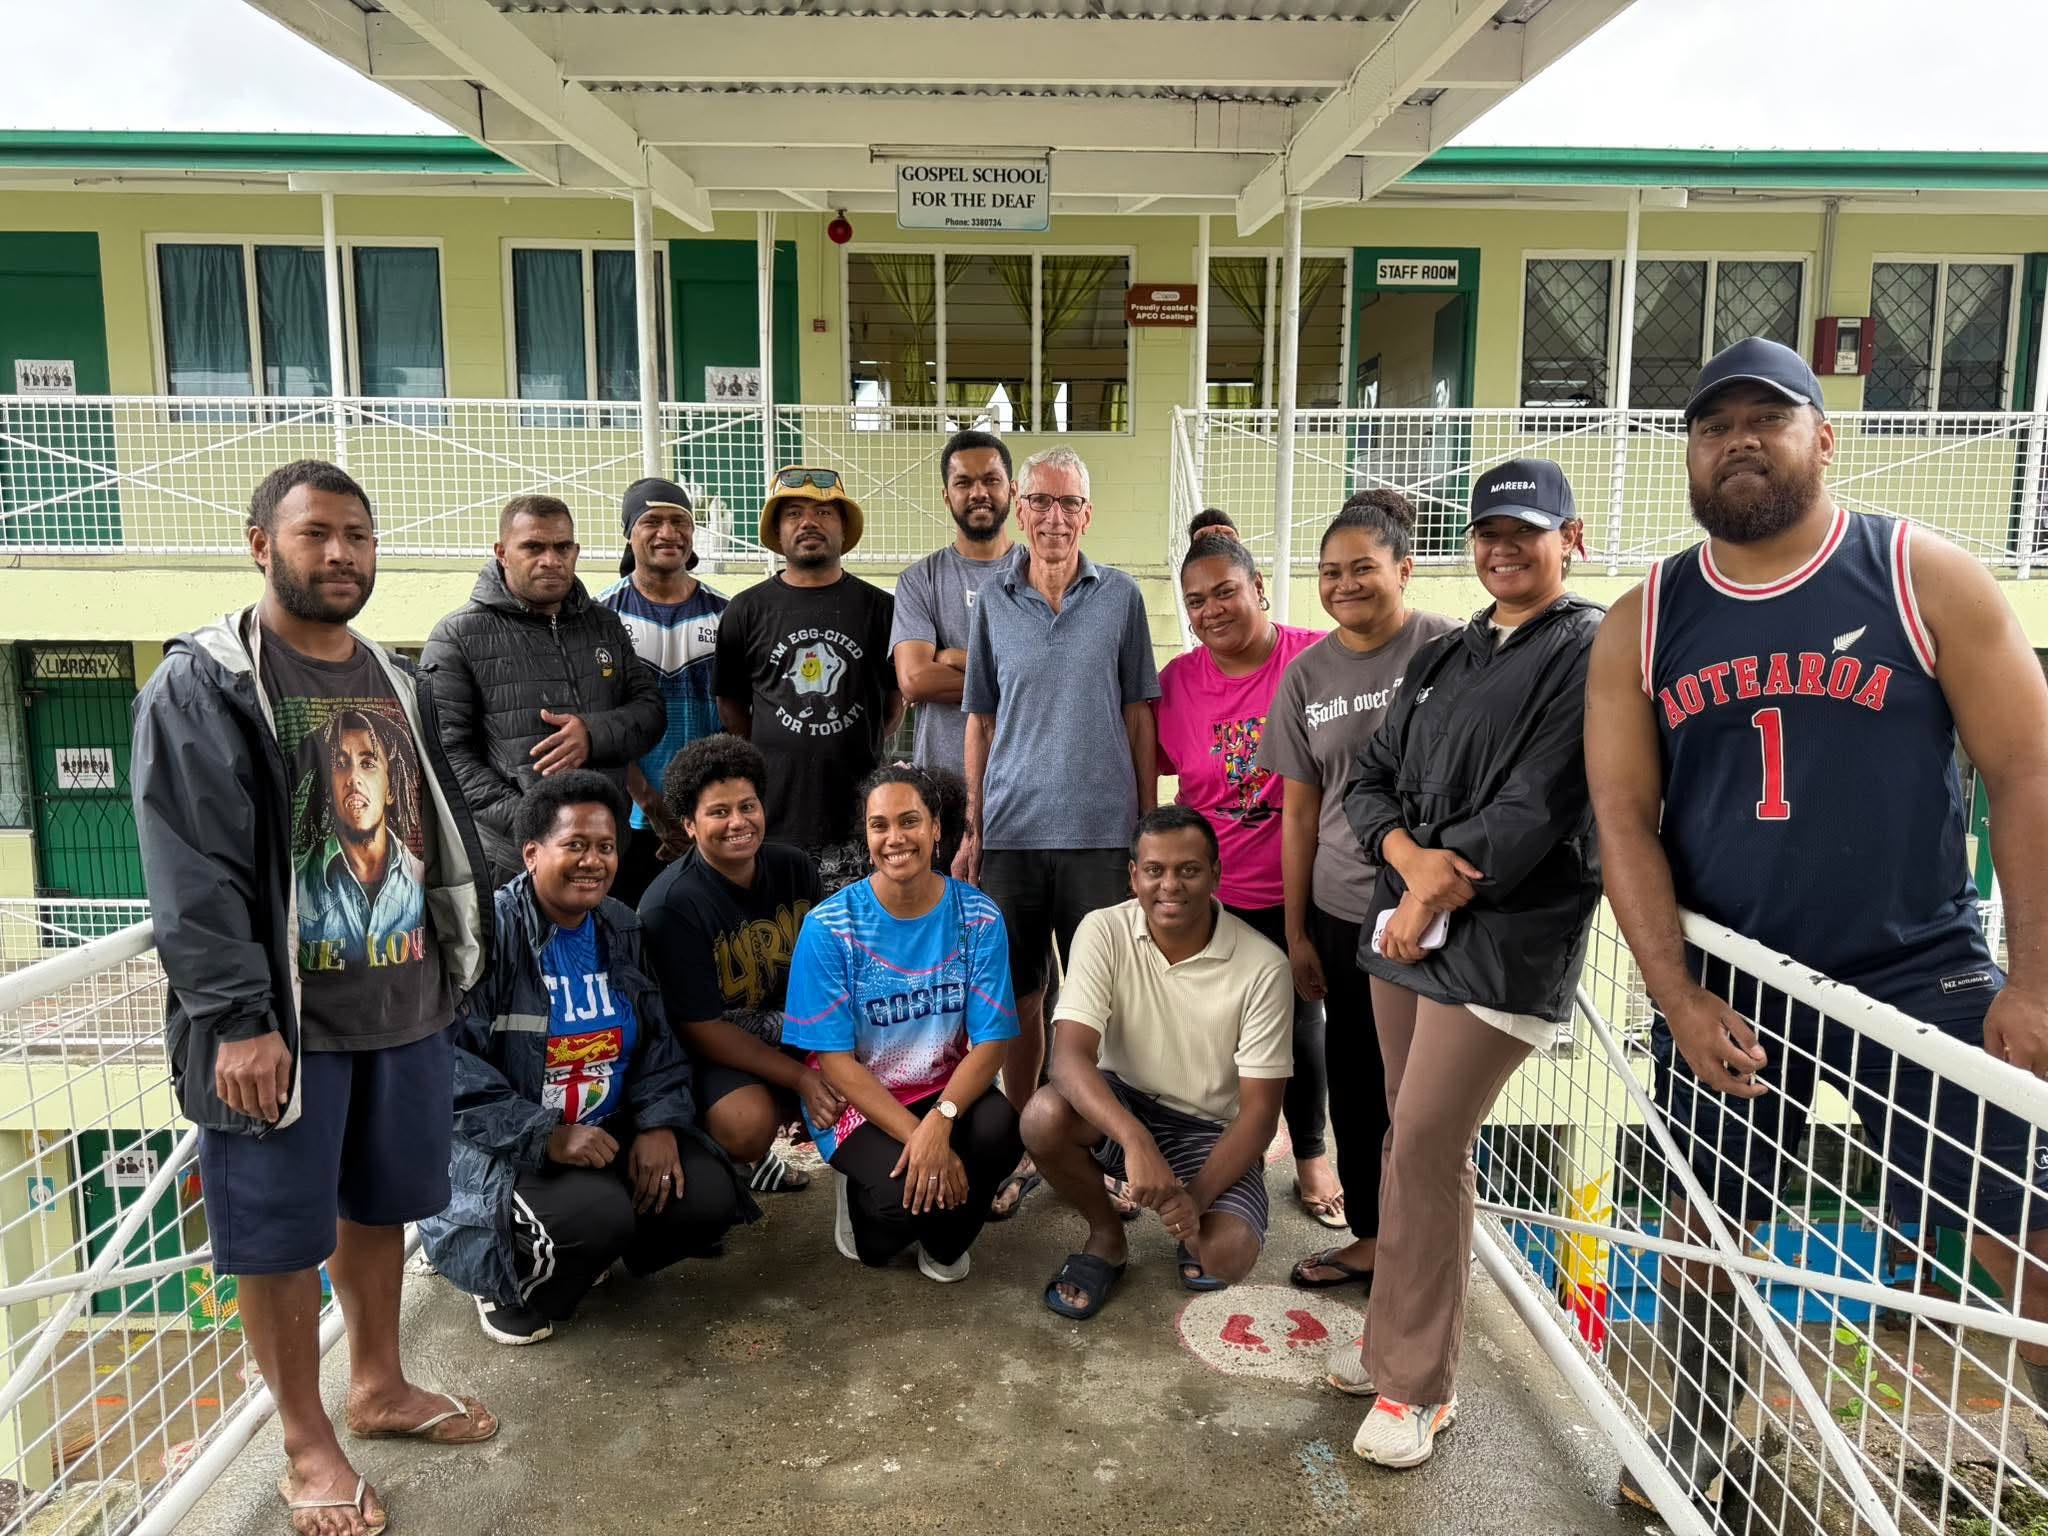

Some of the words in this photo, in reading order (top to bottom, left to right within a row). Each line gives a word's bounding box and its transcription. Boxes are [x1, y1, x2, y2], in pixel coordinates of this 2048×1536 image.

[902, 166, 968, 182] GOSPEL
[972, 168, 1045, 183] SCHOOL
[912, 191, 947, 207] FOR
[951, 192, 986, 208] THE
[992, 193, 1036, 209] DEAF
[945, 217, 970, 227] Phone:
[971, 218, 1002, 227] 3380734
[1379, 265, 1418, 279] STAFF
[1422, 265, 1456, 279] ROOM
[1131, 303, 1160, 312] Proudly
[1160, 313, 1194, 322] Coatings
[1490, 481, 1536, 493] MAREEBA
[769, 642, 788, 667] I'M
[787, 628, 864, 660] EGG-CITED
[46, 658, 108, 674] LIBRARY
[1658, 652, 1893, 729] AOTEAROA
[1305, 695, 1349, 731] Faith
[1353, 688, 1391, 712] over
[775, 705, 803, 734] FOR
[808, 703, 864, 736] TODAY!
[1752, 707, 1790, 820] 1
[299, 936, 346, 971] NE
[366, 926, 426, 968] LOV
[1943, 980, 1957, 989] NZ
[864, 982, 966, 1027] GOSE
